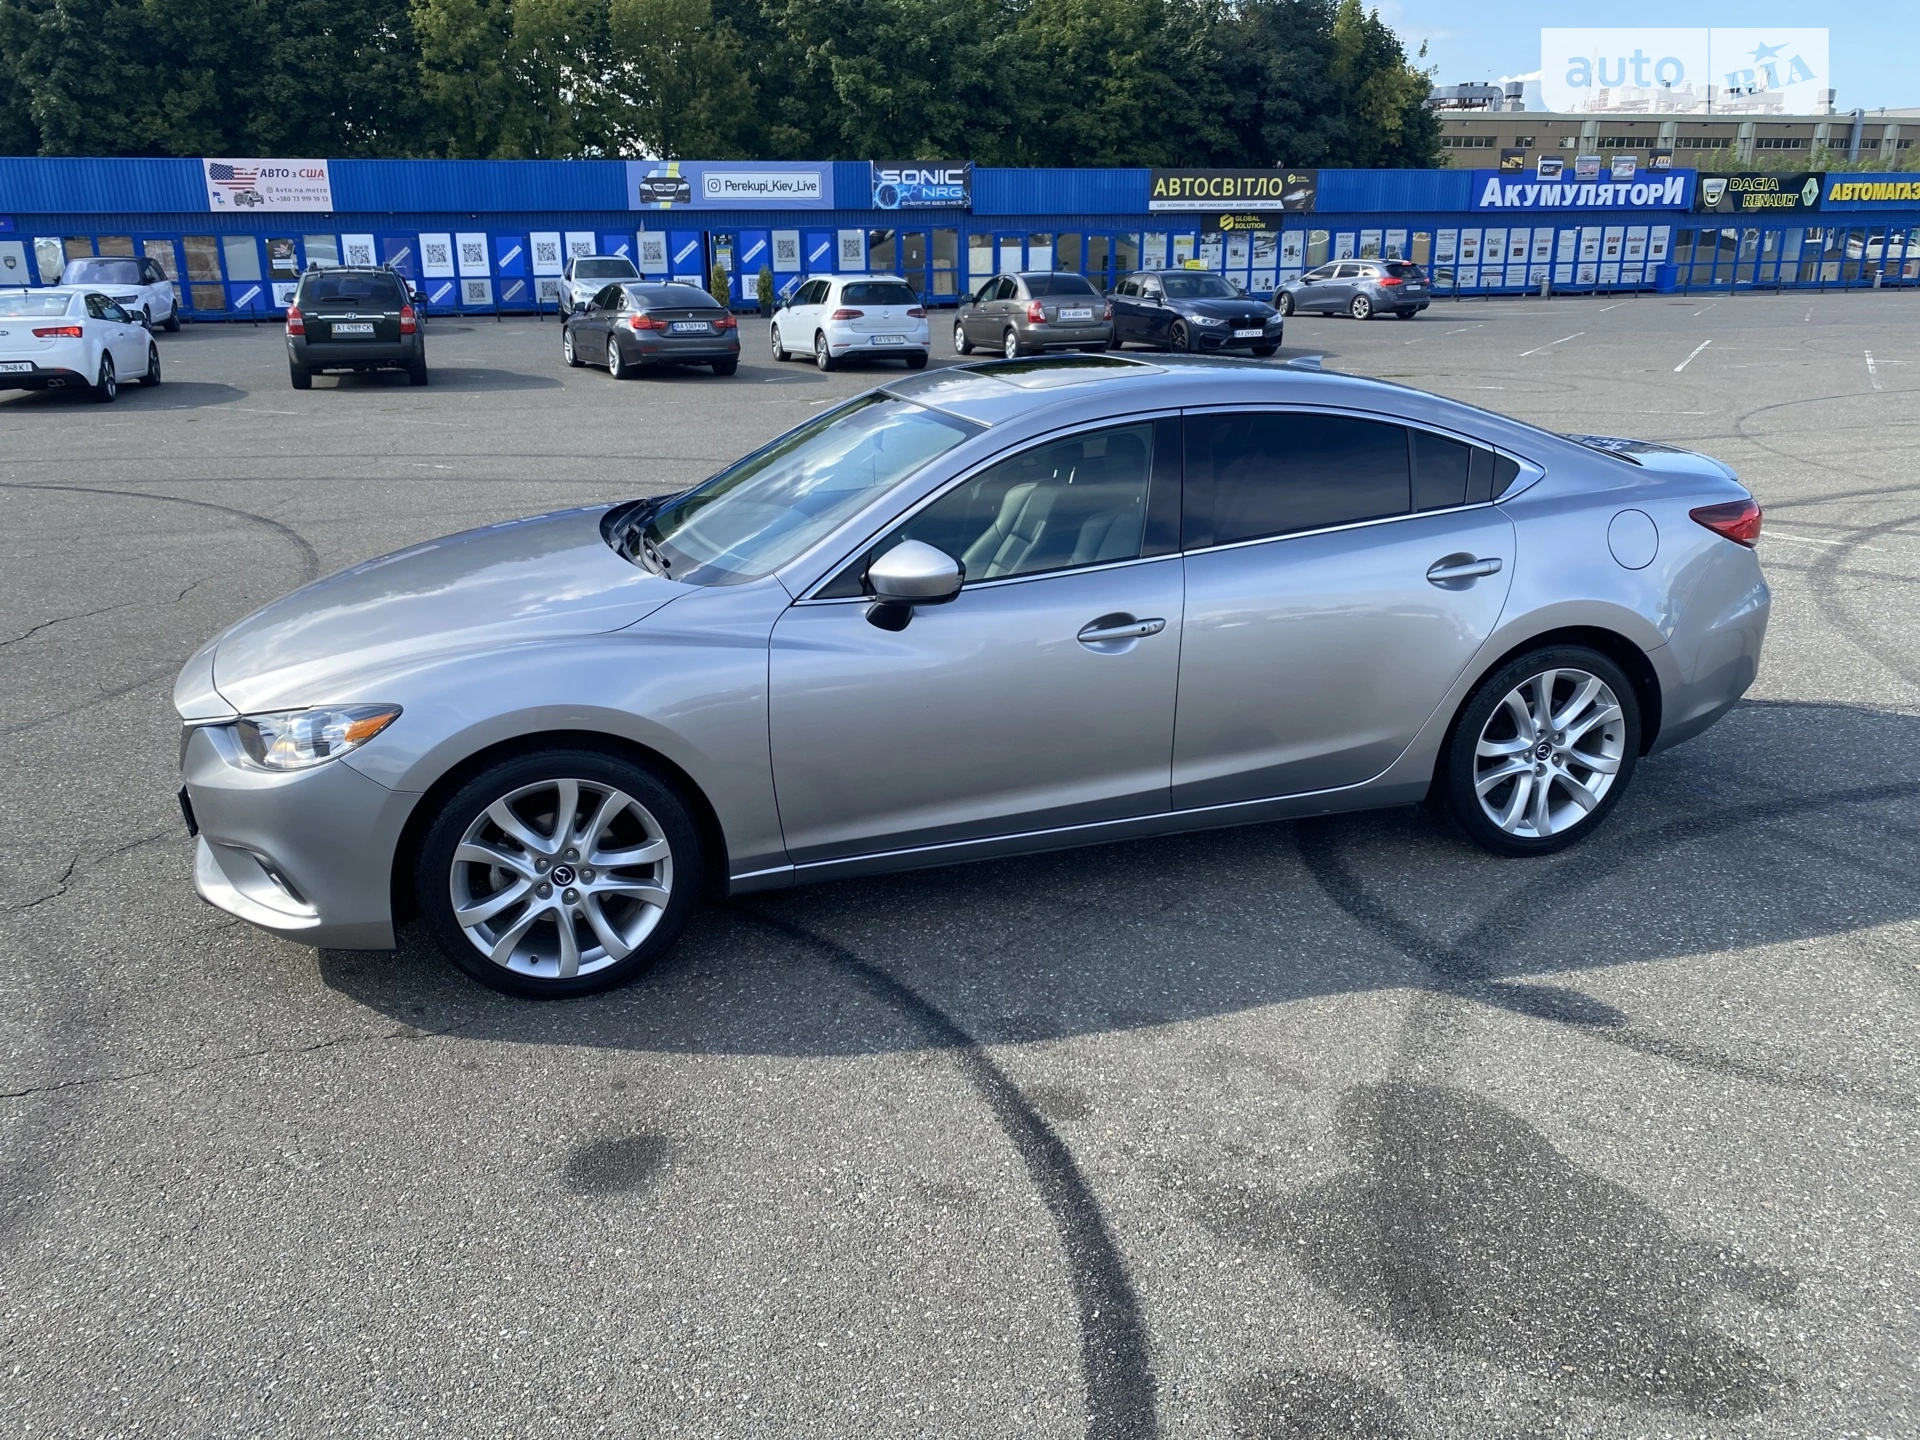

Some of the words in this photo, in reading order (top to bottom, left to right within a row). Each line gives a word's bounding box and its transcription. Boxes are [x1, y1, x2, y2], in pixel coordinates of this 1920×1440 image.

[260, 168, 289, 178] АВТО
[299, 168, 325, 178] США
[880, 169, 963, 184] SONIC
[725, 180, 817, 194] Perekupi_Kiev_Live
[1153, 177, 1283, 197] АВТОСВІТЛО
[1729, 178, 1779, 191] DACIA
[922, 187, 962, 197] NRG
[1743, 193, 1799, 208] RENAULT
